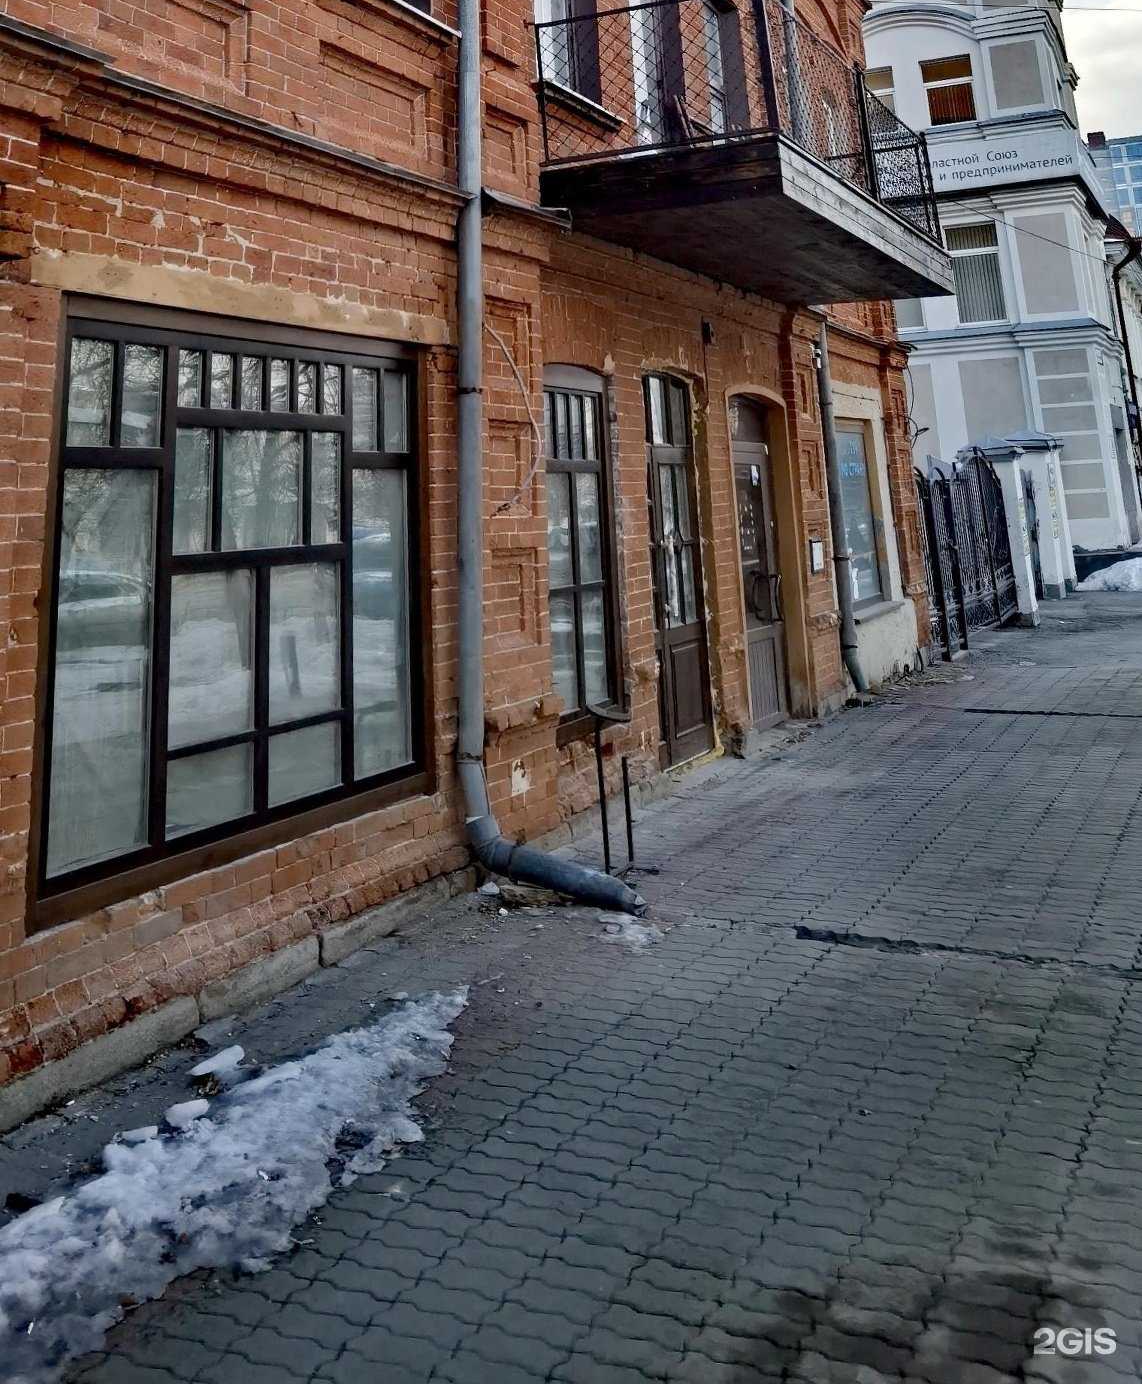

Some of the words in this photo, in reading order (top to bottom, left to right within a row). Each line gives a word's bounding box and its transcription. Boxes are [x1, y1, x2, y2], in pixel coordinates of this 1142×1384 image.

[931, 153, 979, 168] ластной
[986, 150, 1018, 162] Союз
[939, 172, 946, 181] и
[952, 154, 1073, 180] предпринимателей
